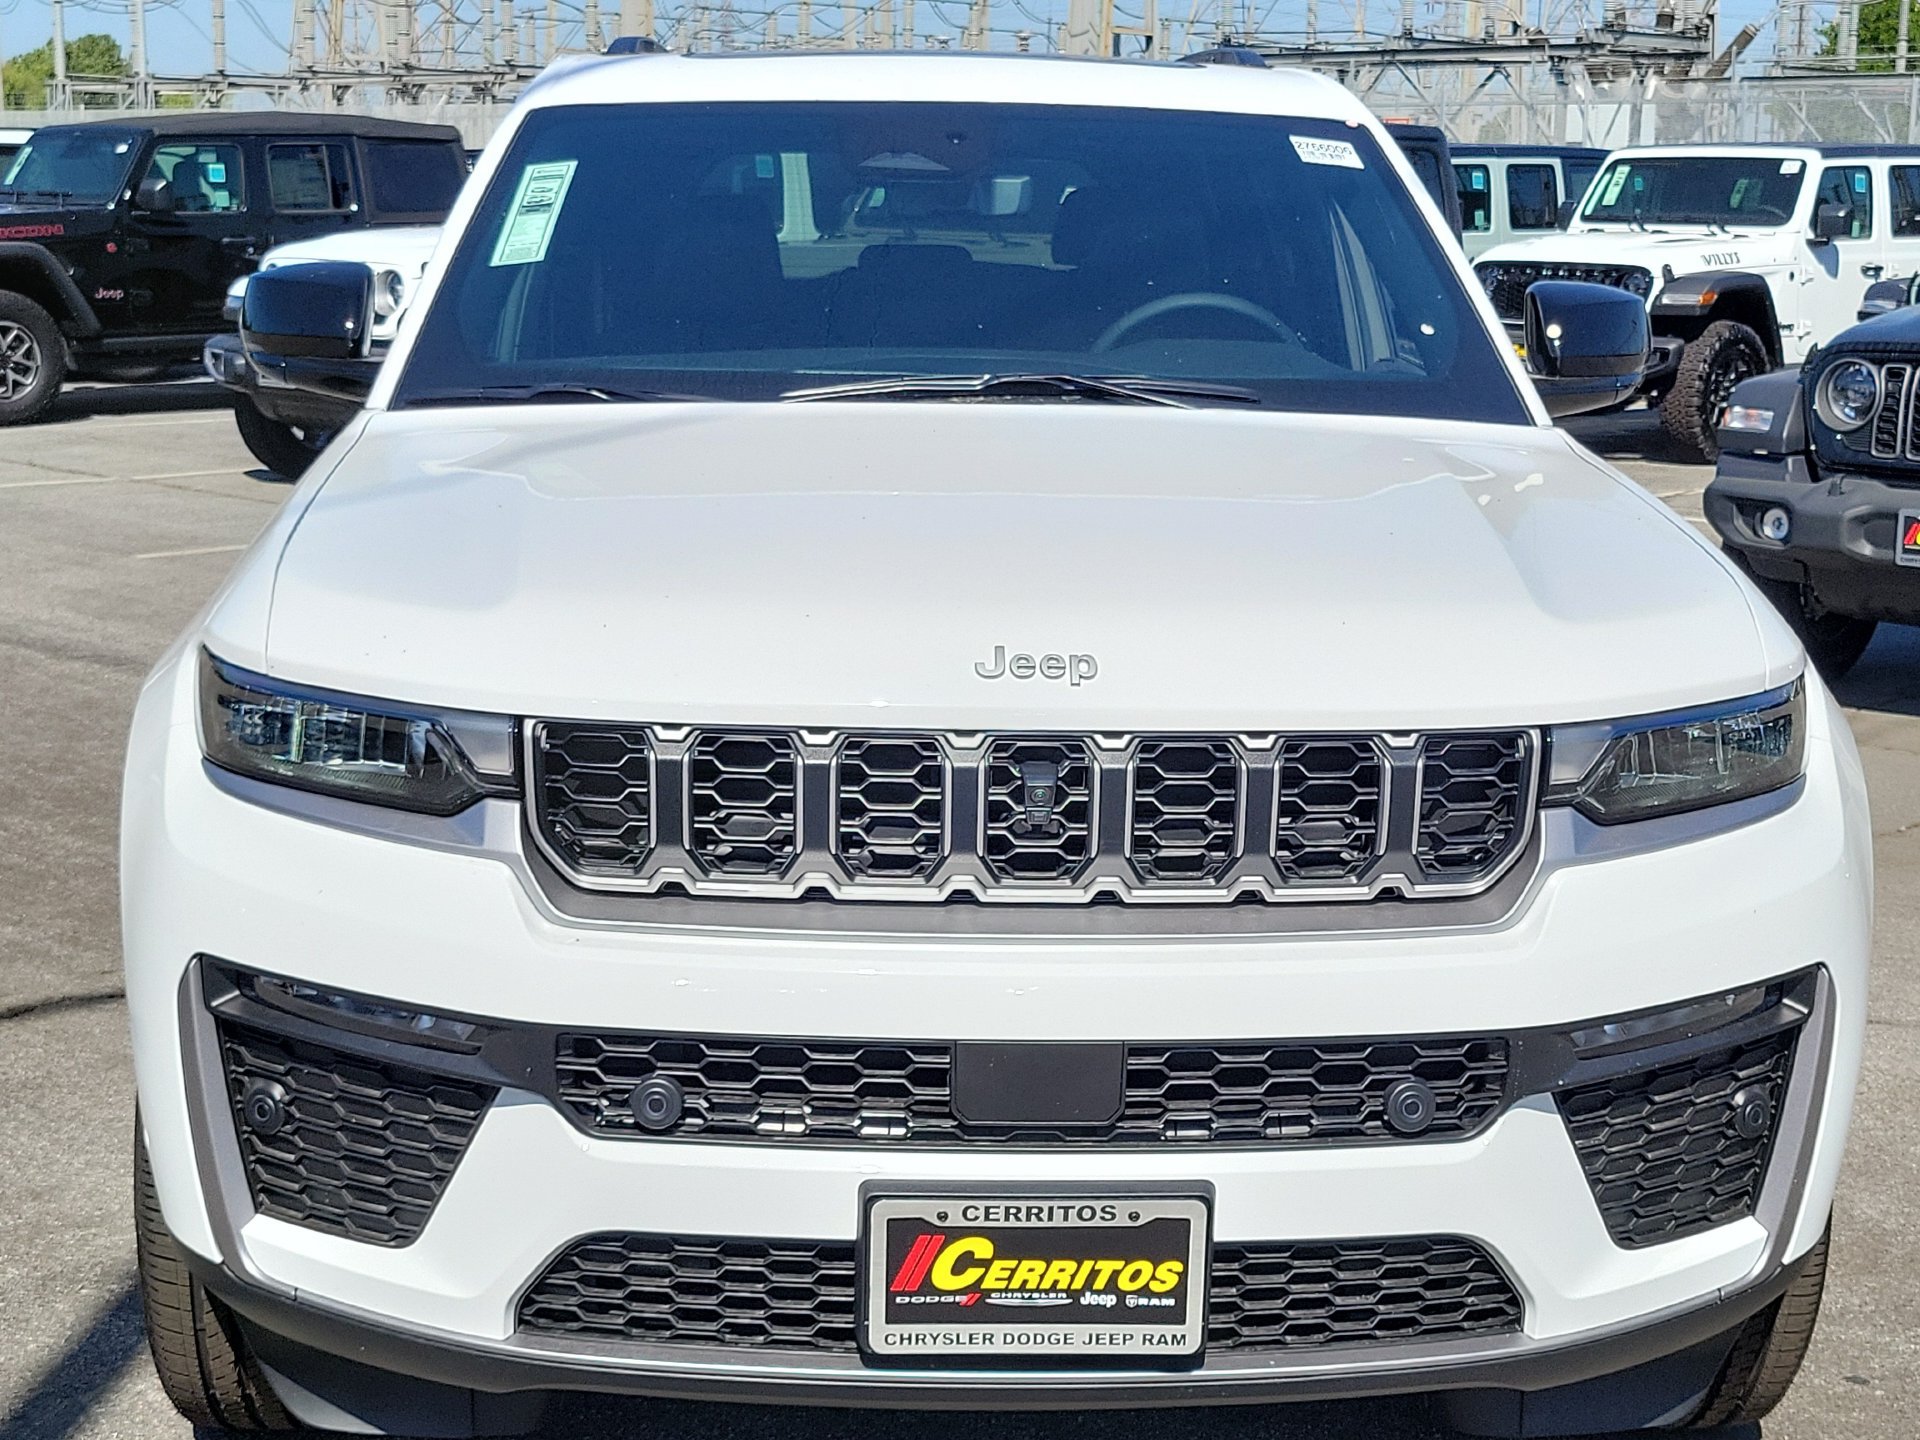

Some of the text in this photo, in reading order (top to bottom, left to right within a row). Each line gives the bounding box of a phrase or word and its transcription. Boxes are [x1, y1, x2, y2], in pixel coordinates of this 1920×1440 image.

[974, 645, 1098, 687] Jeep
[961, 1205, 1117, 1223] CERRITOS
[895, 1295, 968, 1304] DODGE
[1079, 1291, 1117, 1308] Jeep
[1137, 1297, 1176, 1307] RAM
[884, 1332, 1187, 1347] CHRYSLER DODGE JEEP RAM
